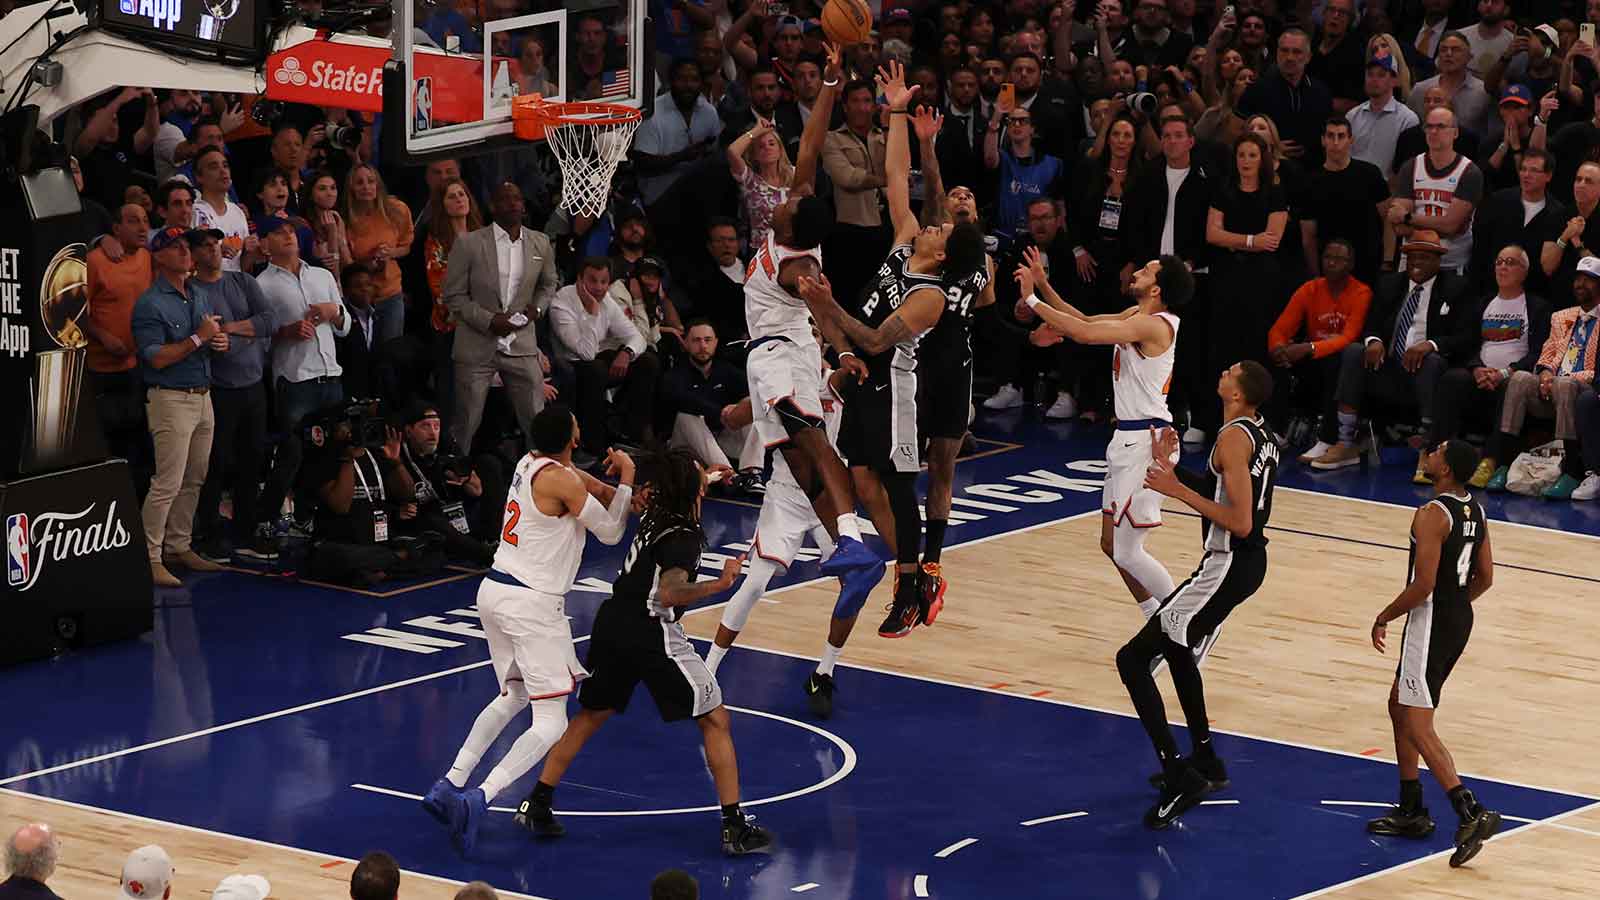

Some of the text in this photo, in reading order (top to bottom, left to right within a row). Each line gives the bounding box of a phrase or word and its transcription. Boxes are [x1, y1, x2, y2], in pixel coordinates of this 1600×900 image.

[140, 0, 181, 31] App
[862, 291, 880, 318] 2
[948, 286, 974, 317] 24
[0, 317, 30, 359] App
[1257, 465, 1271, 511] 1
[18, 500, 131, 592] Finals
[502, 498, 521, 548] 2
[1456, 541, 1475, 587] 4
[340, 604, 490, 655] NE
